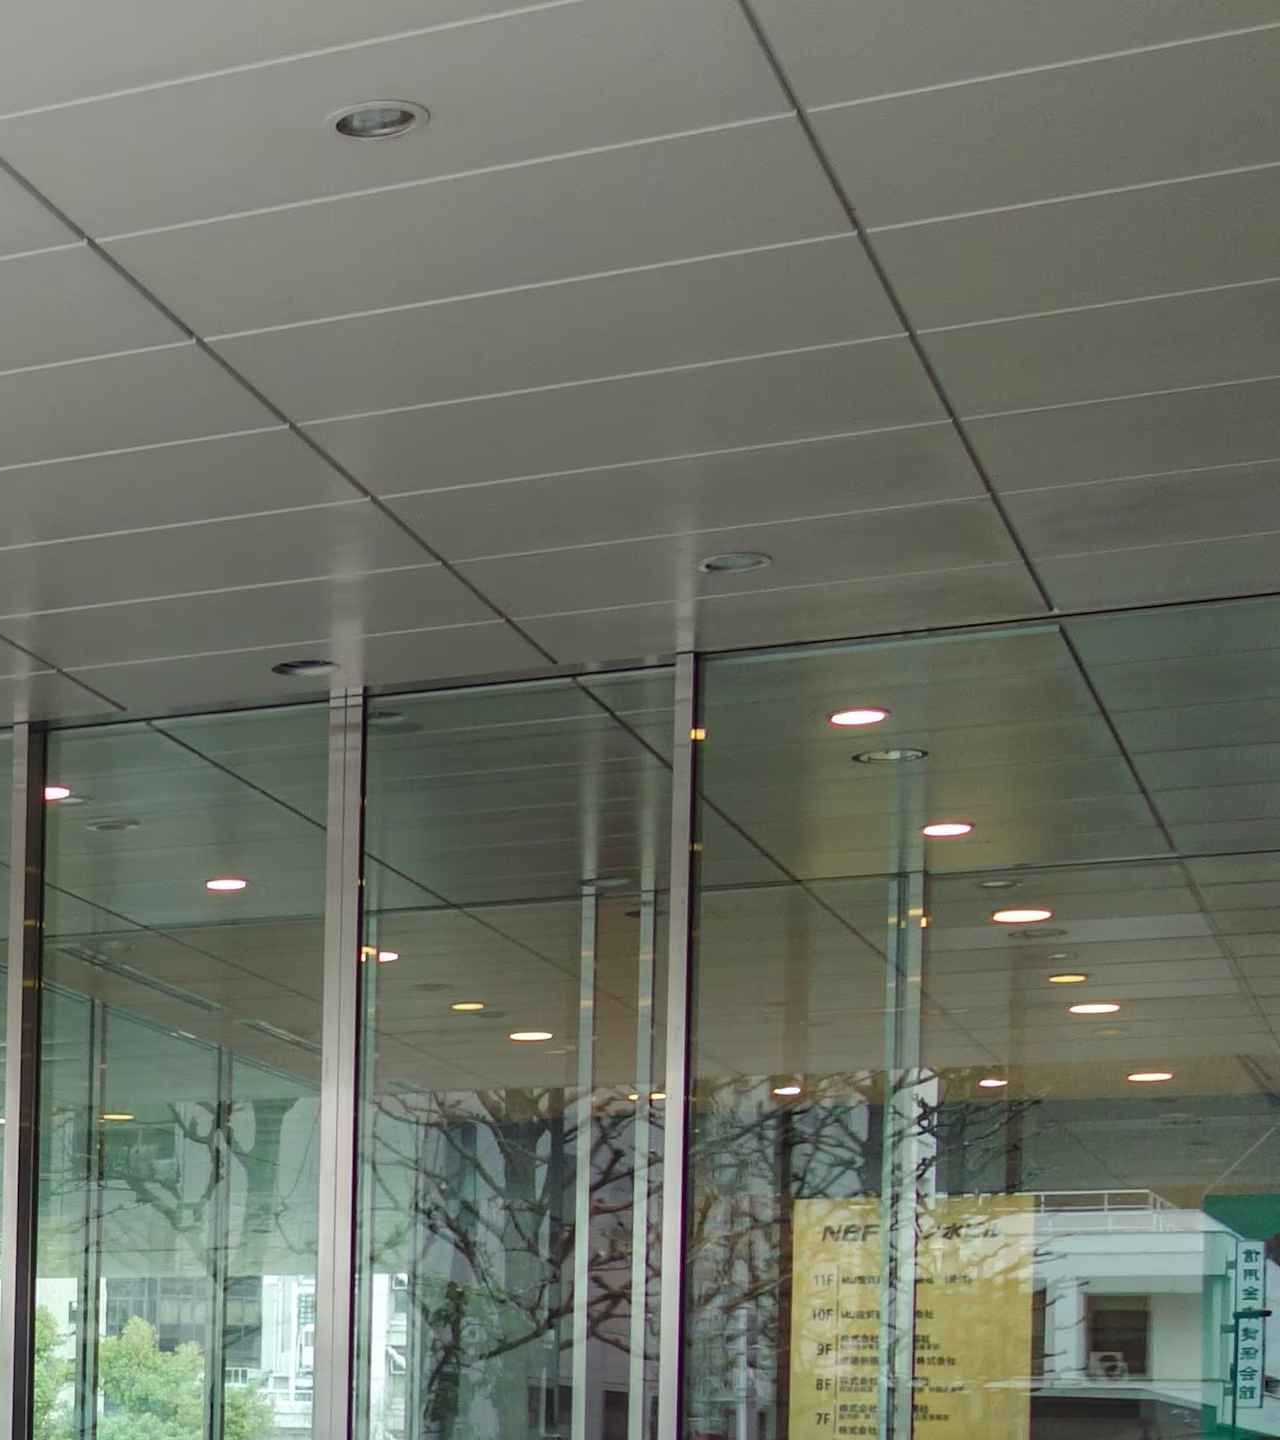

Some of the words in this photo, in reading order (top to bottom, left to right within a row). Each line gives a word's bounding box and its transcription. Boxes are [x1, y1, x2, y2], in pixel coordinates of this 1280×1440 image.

[813, 1274, 833, 1286] 11F
[817, 1343, 832, 1355] 9F
[816, 1379, 831, 1391] 8F
[816, 1413, 831, 1425] 7F
